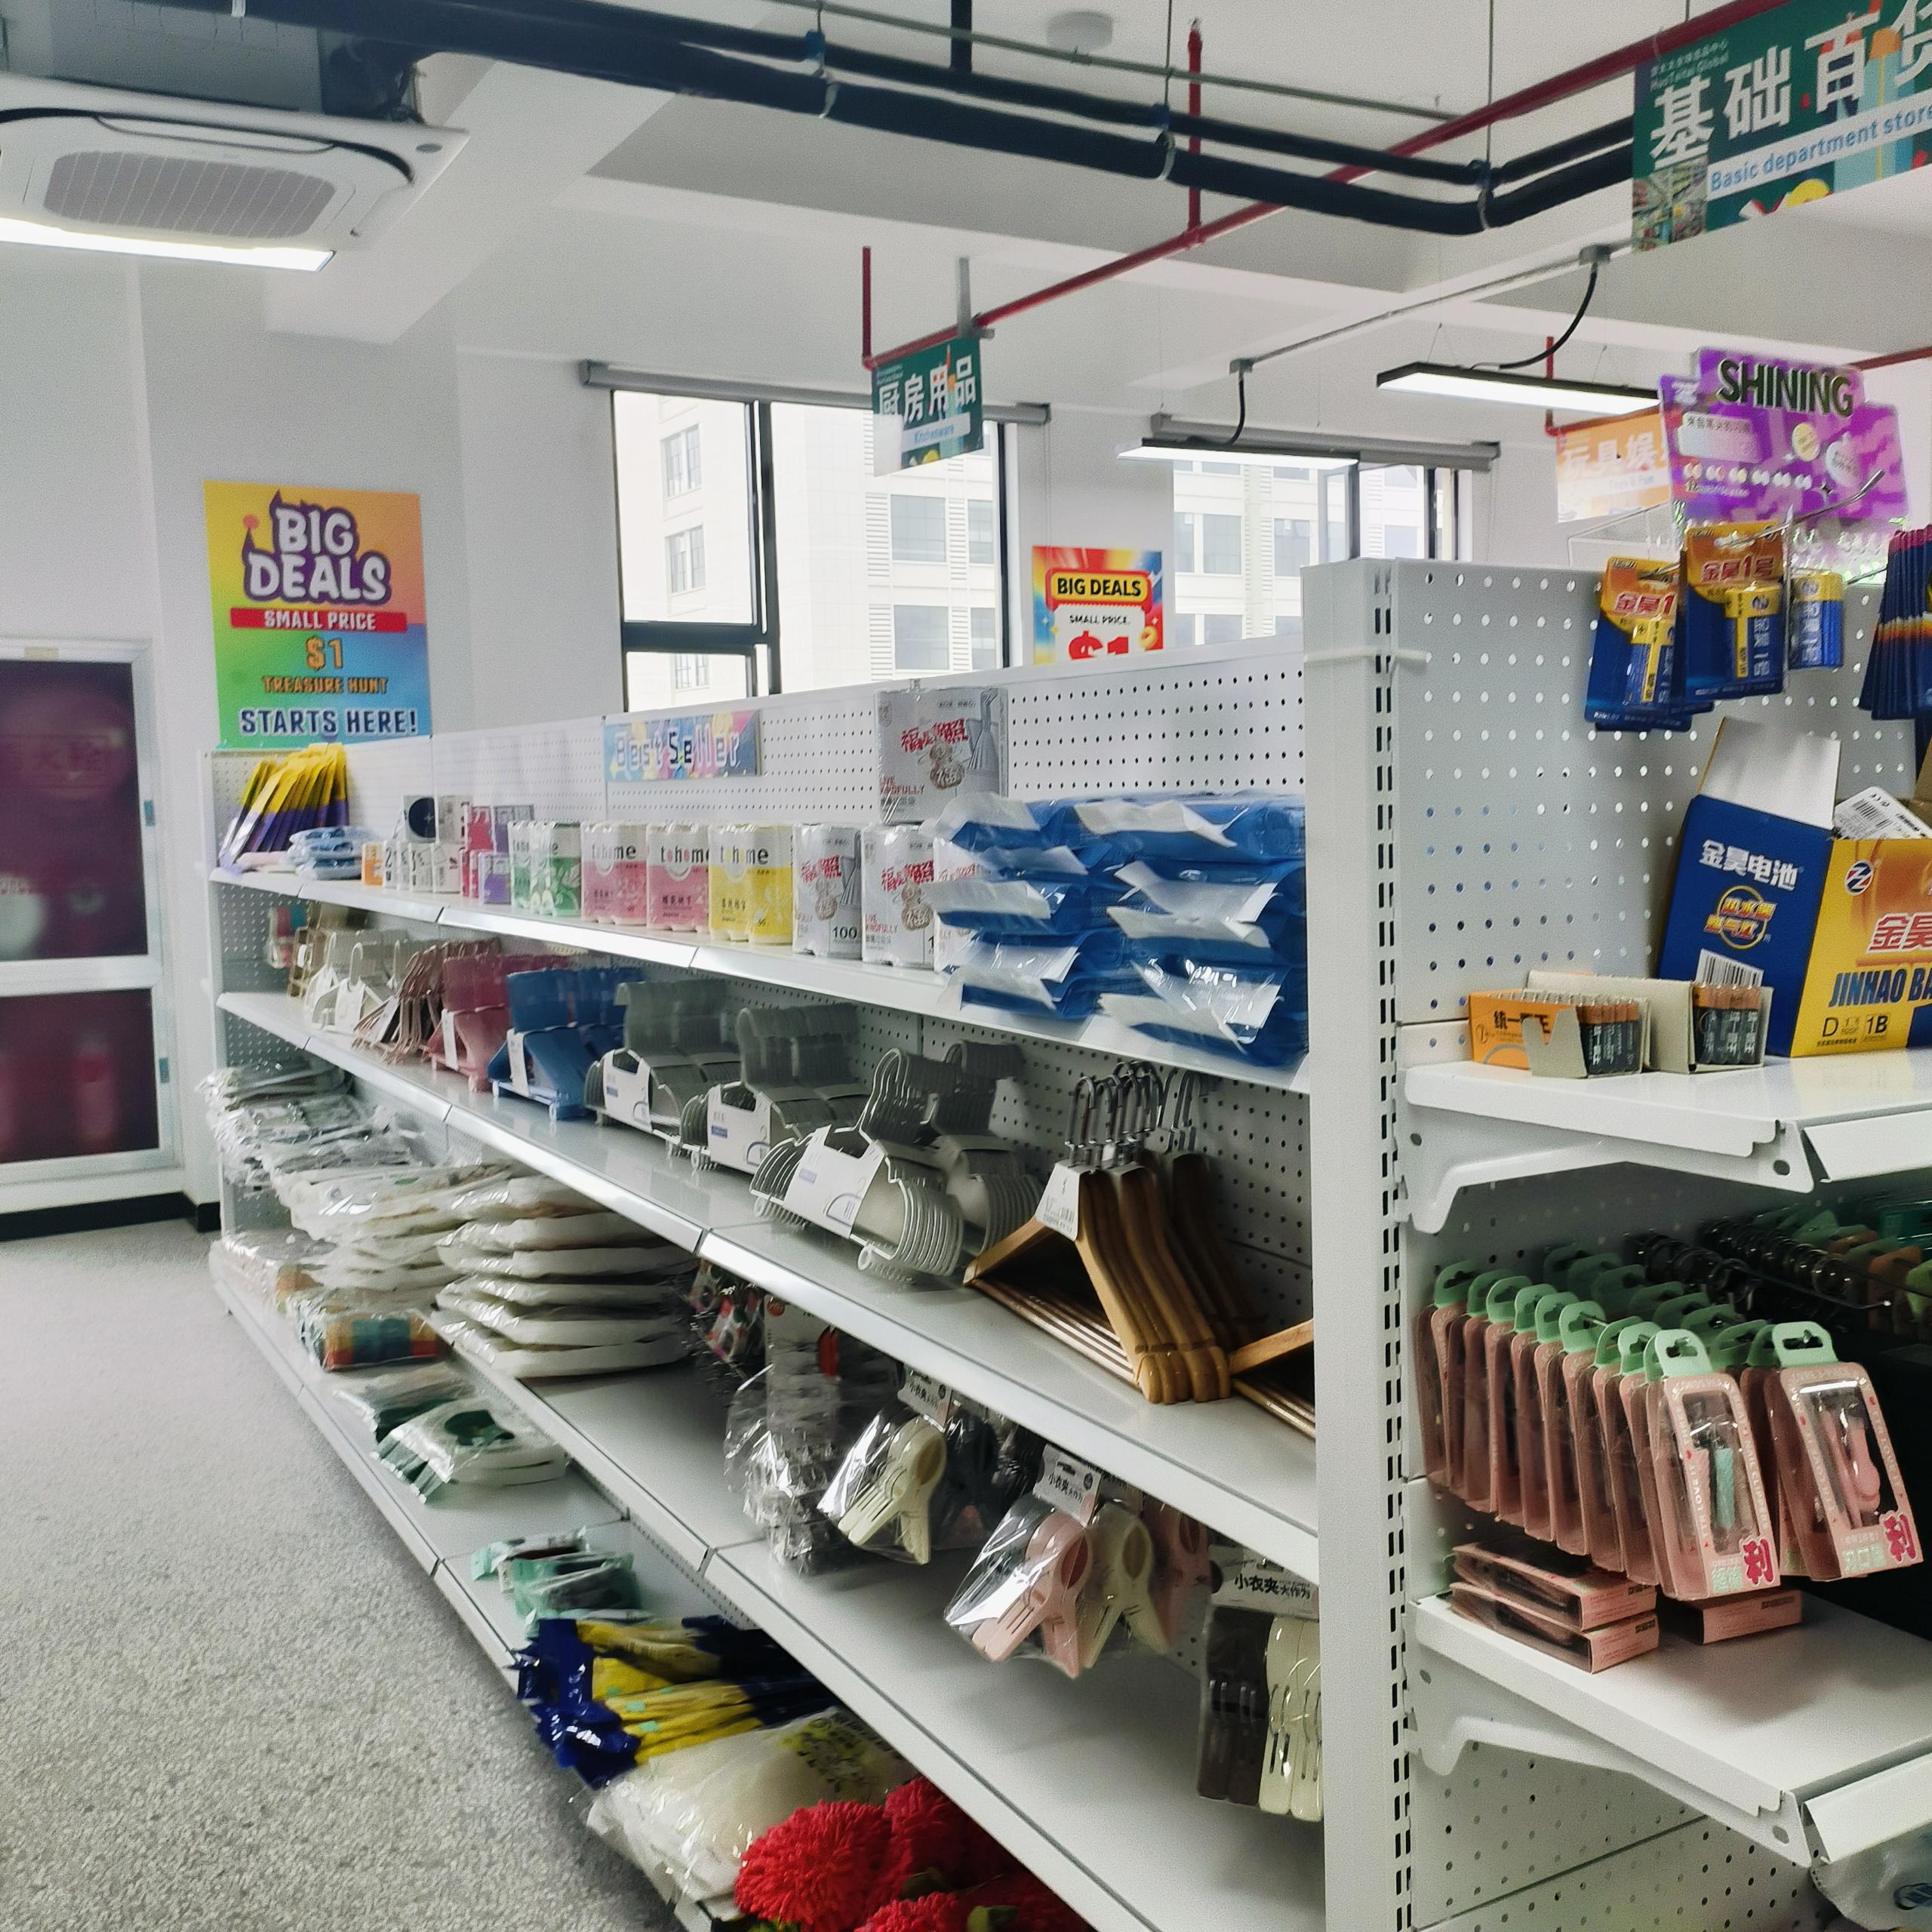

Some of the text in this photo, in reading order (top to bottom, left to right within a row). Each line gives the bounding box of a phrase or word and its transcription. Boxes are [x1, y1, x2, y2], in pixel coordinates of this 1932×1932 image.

[1710, 106, 1932, 192] Basic department store
[879, 354, 977, 425] 厨房用品
[1717, 358, 1854, 417] SHINING
[275, 506, 355, 555] BIG
[248, 551, 387, 601] DEALS
[1057, 578, 1141, 596] BIG DEALS
[264, 610, 377, 630] SMALL PRICE
[305, 635, 344, 671] $1
[263, 675, 389, 694] TREASURE HUNT
[240, 708, 417, 734] STARTS HERE!
[615, 723, 740, 773] Best Seller
[832, 926, 857, 940] 100
[1828, 968, 1907, 1008] JINHAO
[1822, 1017, 1839, 1038] D
[1867, 1014, 1889, 1035] 1B
[1692, 1478, 1703, 1512] LOVE
